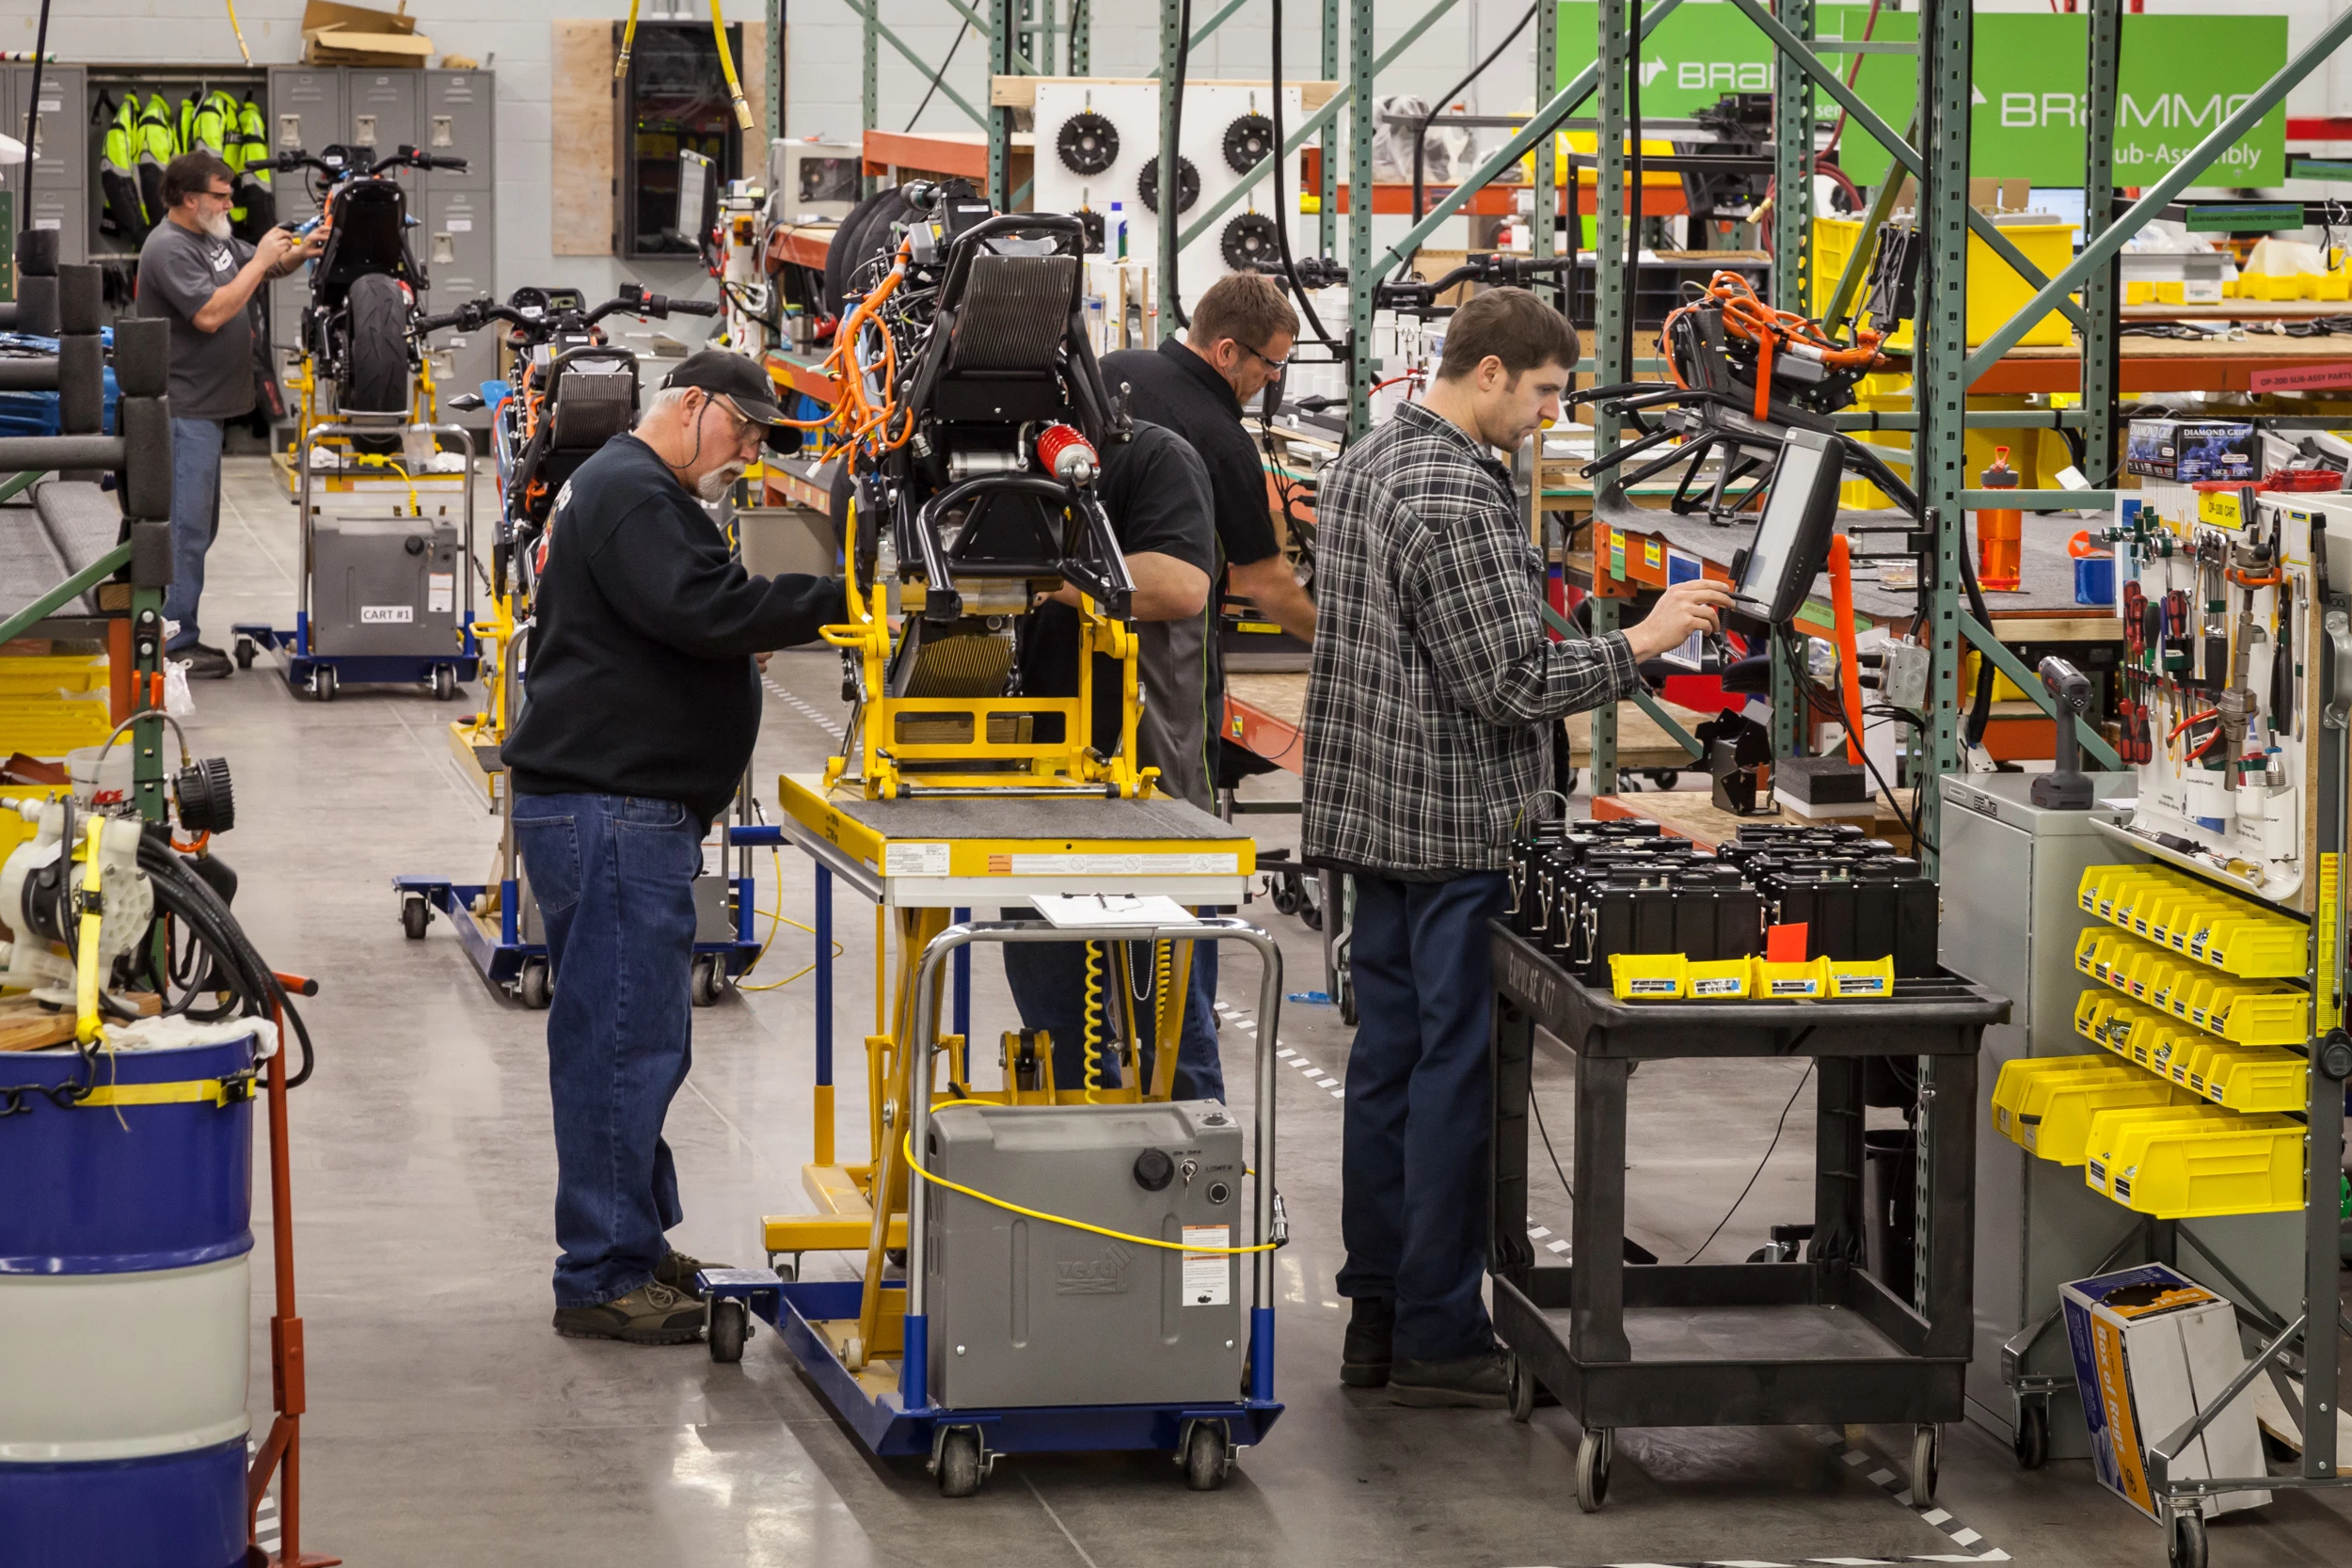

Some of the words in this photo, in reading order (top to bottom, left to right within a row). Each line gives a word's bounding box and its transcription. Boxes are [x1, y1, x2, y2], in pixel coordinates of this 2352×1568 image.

[2114, 142, 2262, 170] ub-Assbly
[2290, 374, 2326, 384] SUB-ASSY
[2328, 372, 2352, 380] PARTS
[2129, 423, 2158, 438] DIAMOND
[2158, 426, 2173, 439] GRIP
[2227, 428, 2247, 436] GRIP
[2208, 501, 2223, 515] OP-100
[2224, 506, 2235, 518] CART
[363, 610, 393, 620] CART
[396, 610, 410, 620] #1
[90, 788, 124, 805] ACE
[1540, 977, 1556, 1016] 477
[1205, 1164, 1233, 1173] LOWER
[2096, 1324, 2108, 1367] Box
[2103, 1370, 2117, 1397] of
[2108, 1400, 2126, 1455] Rags
